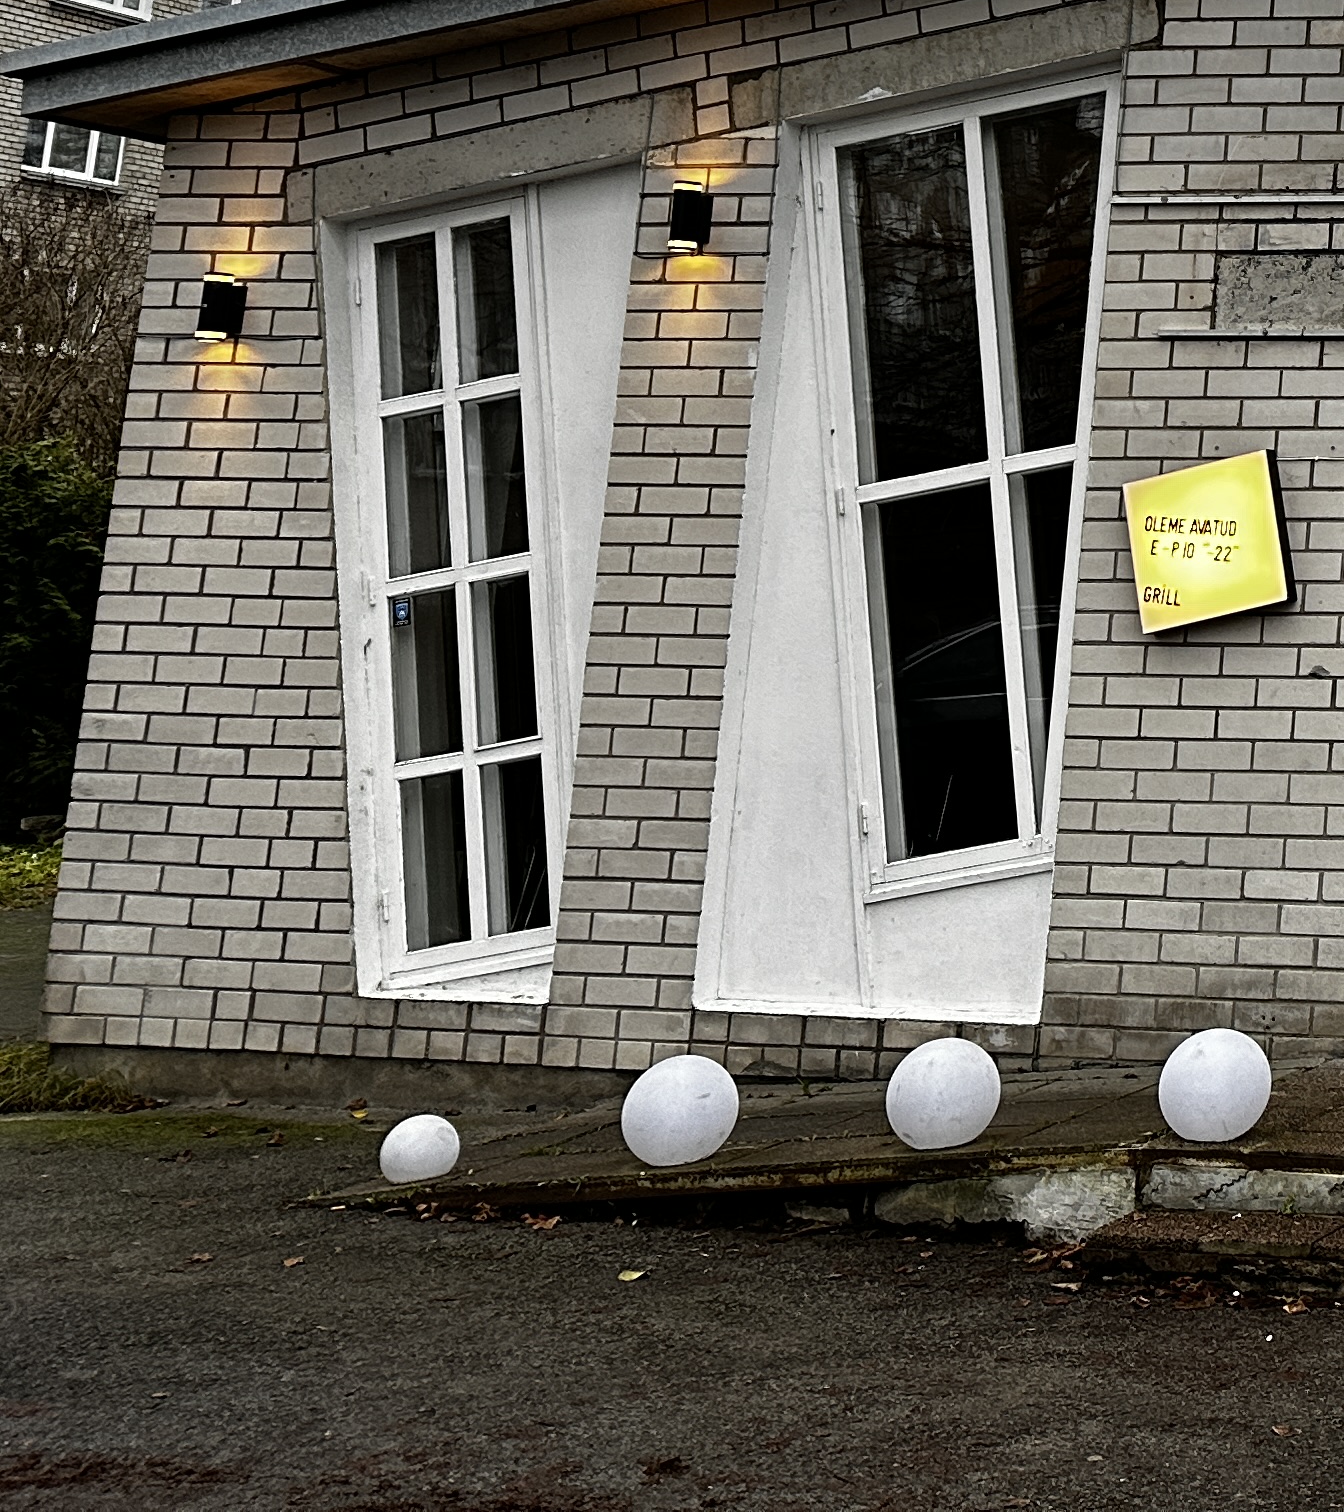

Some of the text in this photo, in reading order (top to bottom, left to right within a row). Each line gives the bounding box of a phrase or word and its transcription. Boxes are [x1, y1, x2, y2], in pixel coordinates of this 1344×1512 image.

[1144, 515, 1237, 537] OLEME AVATUD
[1143, 584, 1181, 607] GRILL
